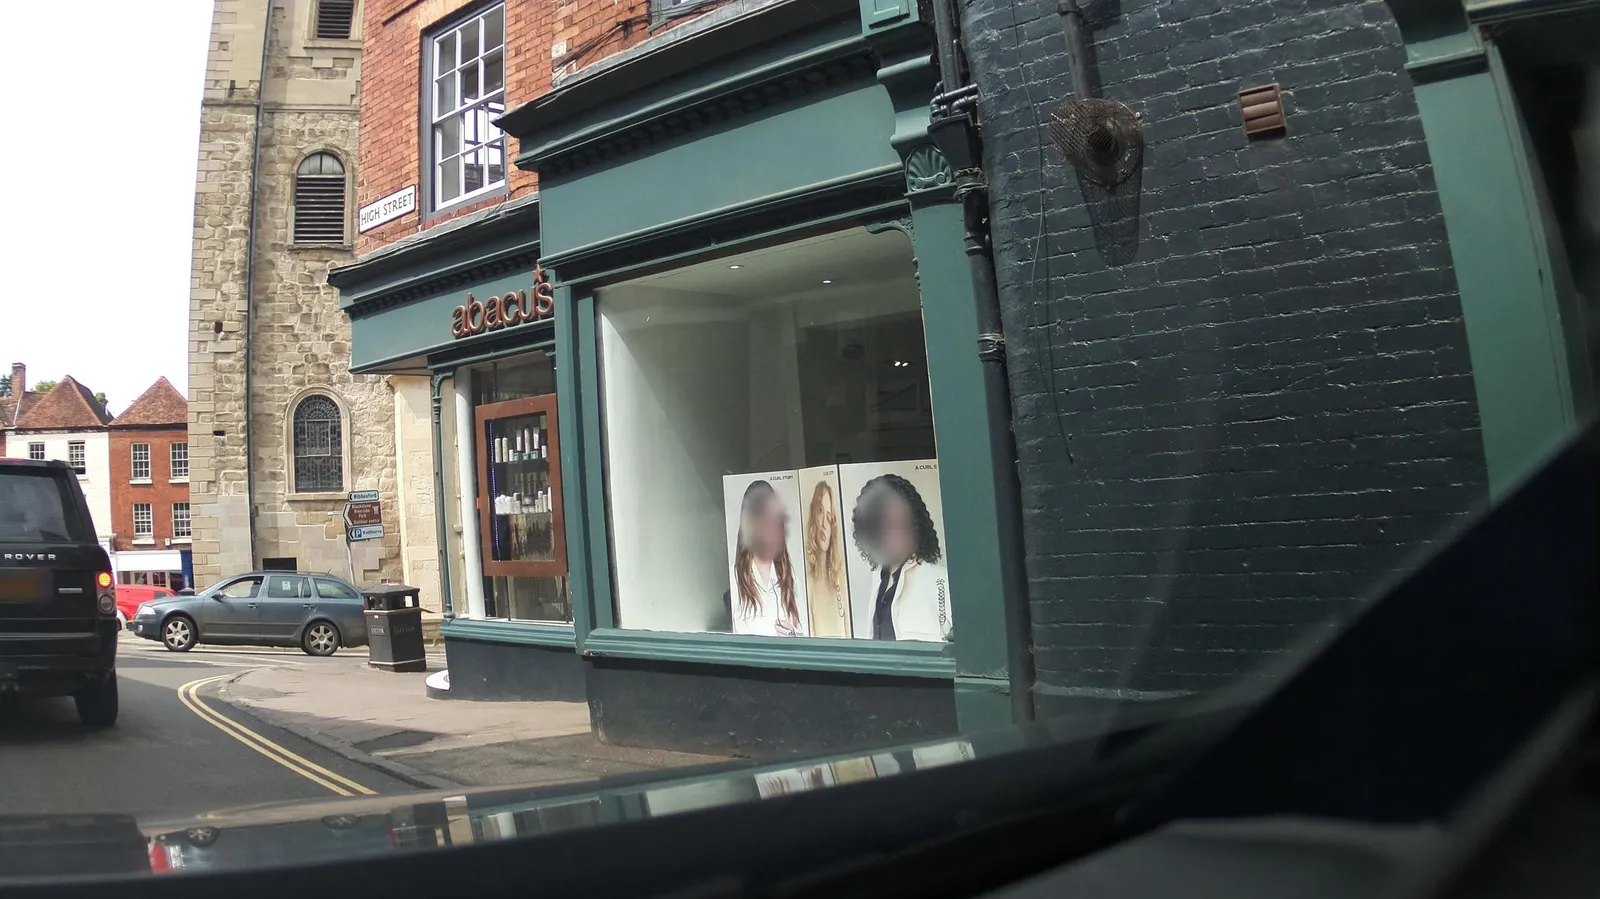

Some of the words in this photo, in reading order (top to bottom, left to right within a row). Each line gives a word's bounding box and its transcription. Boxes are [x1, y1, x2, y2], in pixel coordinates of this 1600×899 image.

[361, 207, 380, 225] HIGH
[383, 192, 413, 216] STREET
[452, 282, 554, 337] abacus
